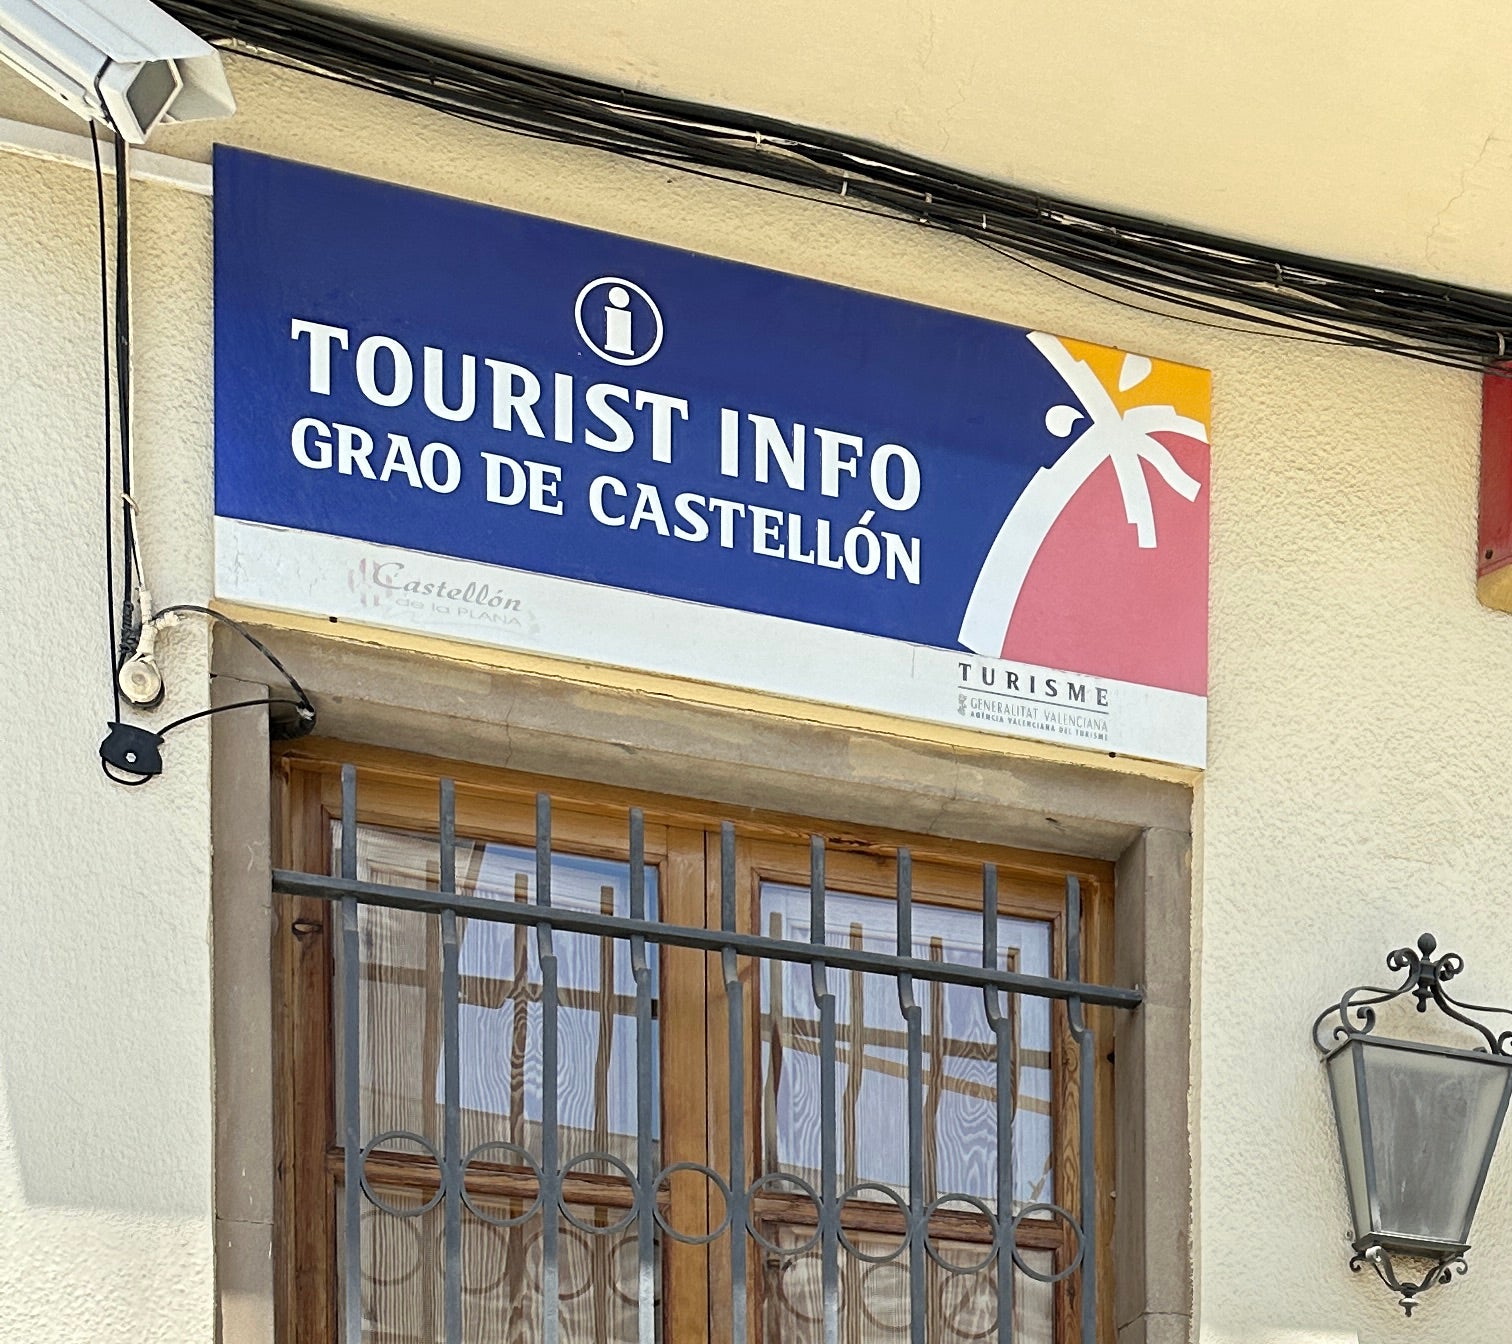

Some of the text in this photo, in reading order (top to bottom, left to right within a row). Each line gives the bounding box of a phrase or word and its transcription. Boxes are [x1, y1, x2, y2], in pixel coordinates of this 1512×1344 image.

[290, 317, 922, 513] TOURIST INFO
[291, 416, 922, 586] GRAO DE CASTELLÓN
[373, 562, 523, 612] Castellón
[958, 661, 1109, 707] TURISME
[970, 697, 1109, 733] GENERALITAT VALENCIANA
[1007, 717, 1056, 733] VALENCIANA
